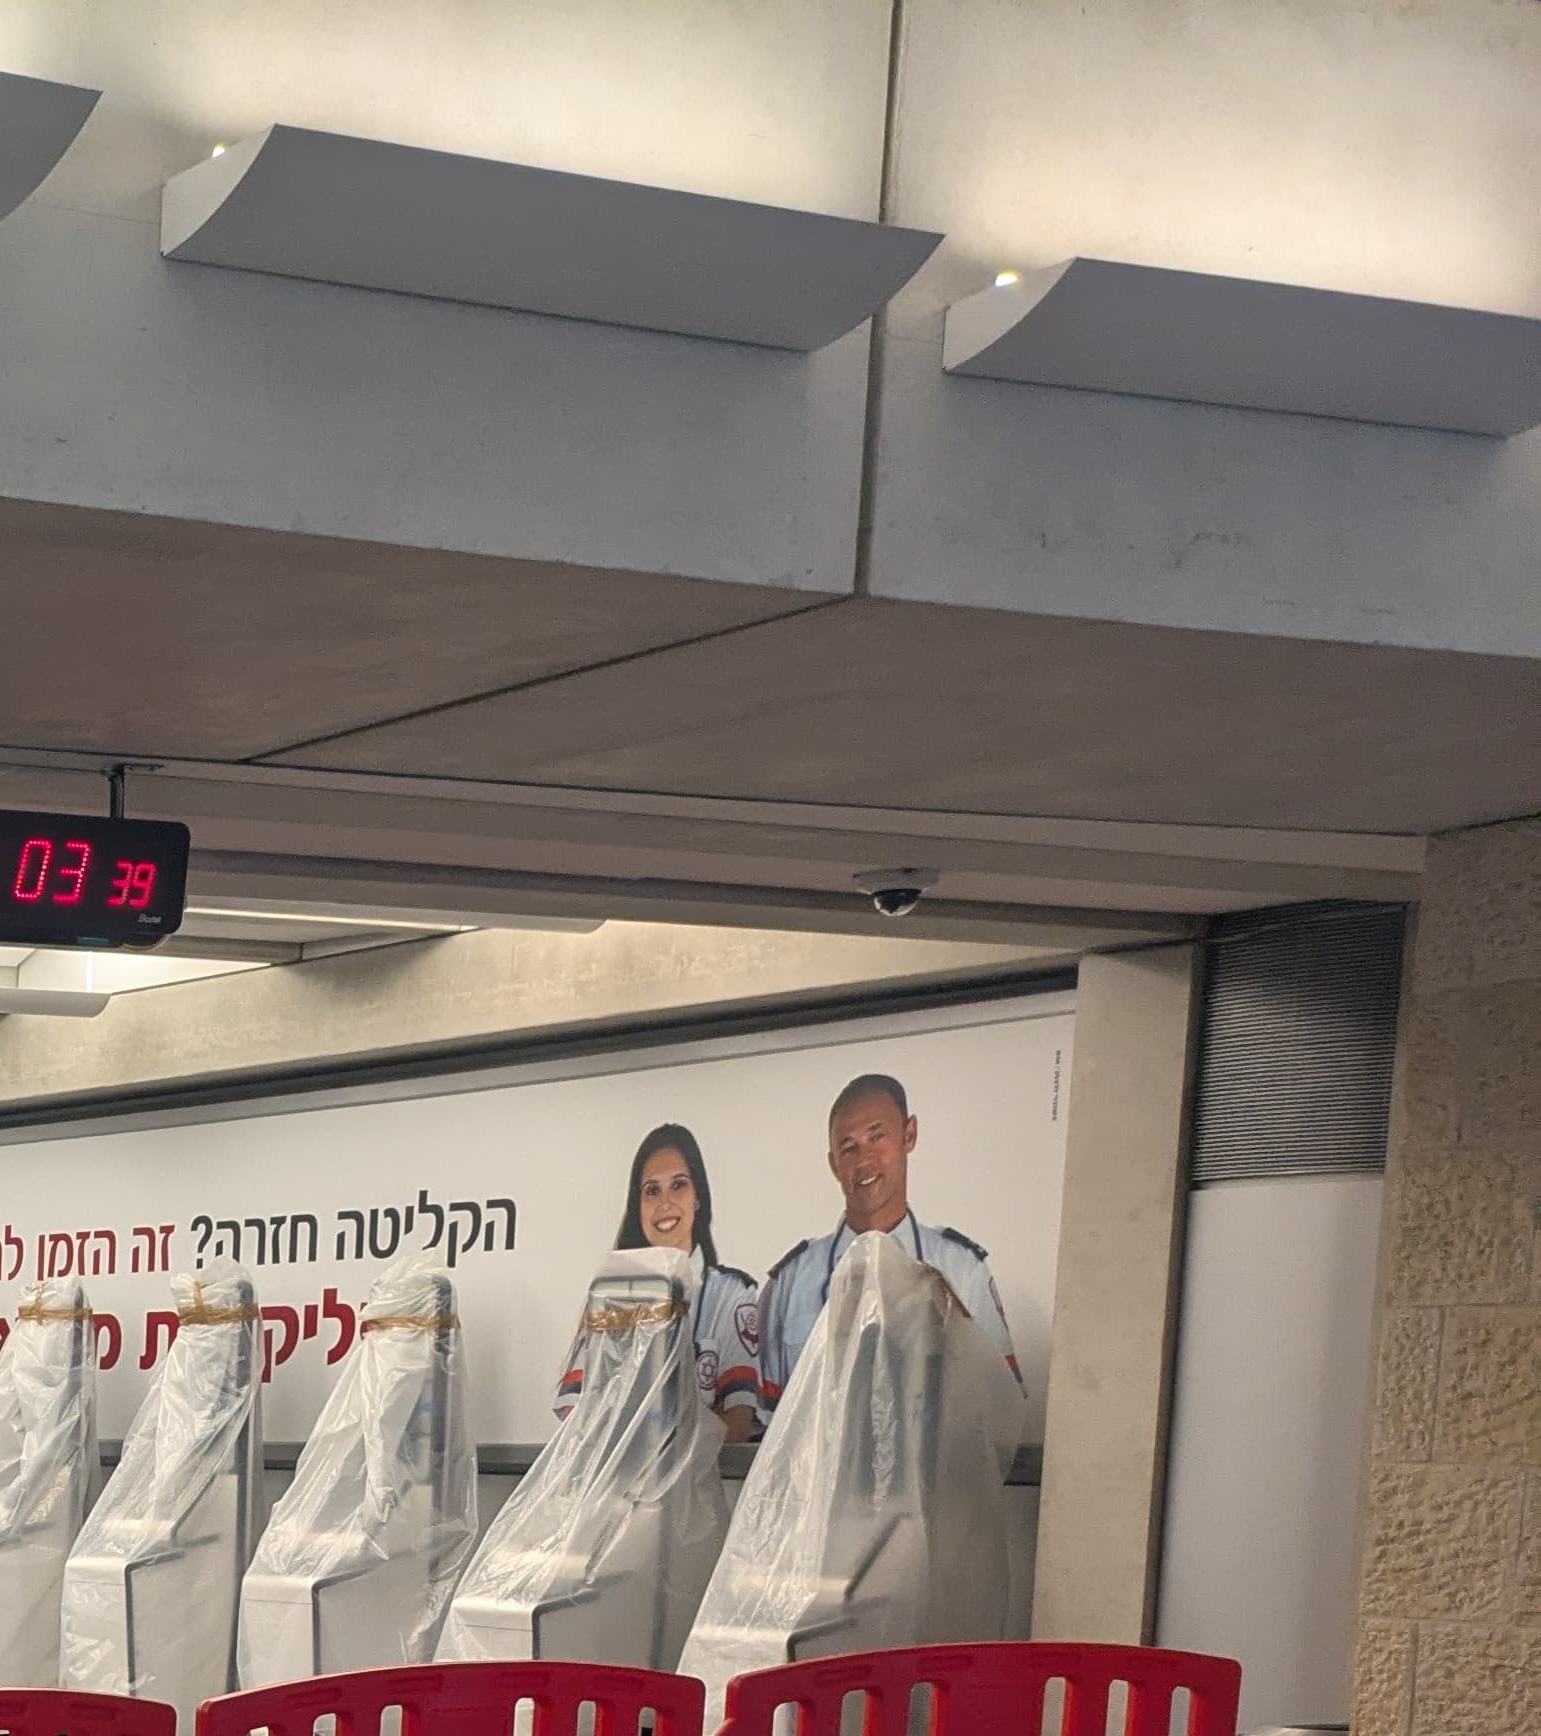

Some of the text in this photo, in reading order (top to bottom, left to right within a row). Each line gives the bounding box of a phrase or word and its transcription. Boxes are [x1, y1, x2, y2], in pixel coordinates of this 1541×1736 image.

[14, 838, 91, 904] 03
[107, 861, 157, 907] 39
[36, 1229, 117, 1281] הזמן
[130, 1224, 176, 1274] זה
[190, 1214, 318, 1269] חזרה?
[335, 1189, 517, 1268] הקליטה
